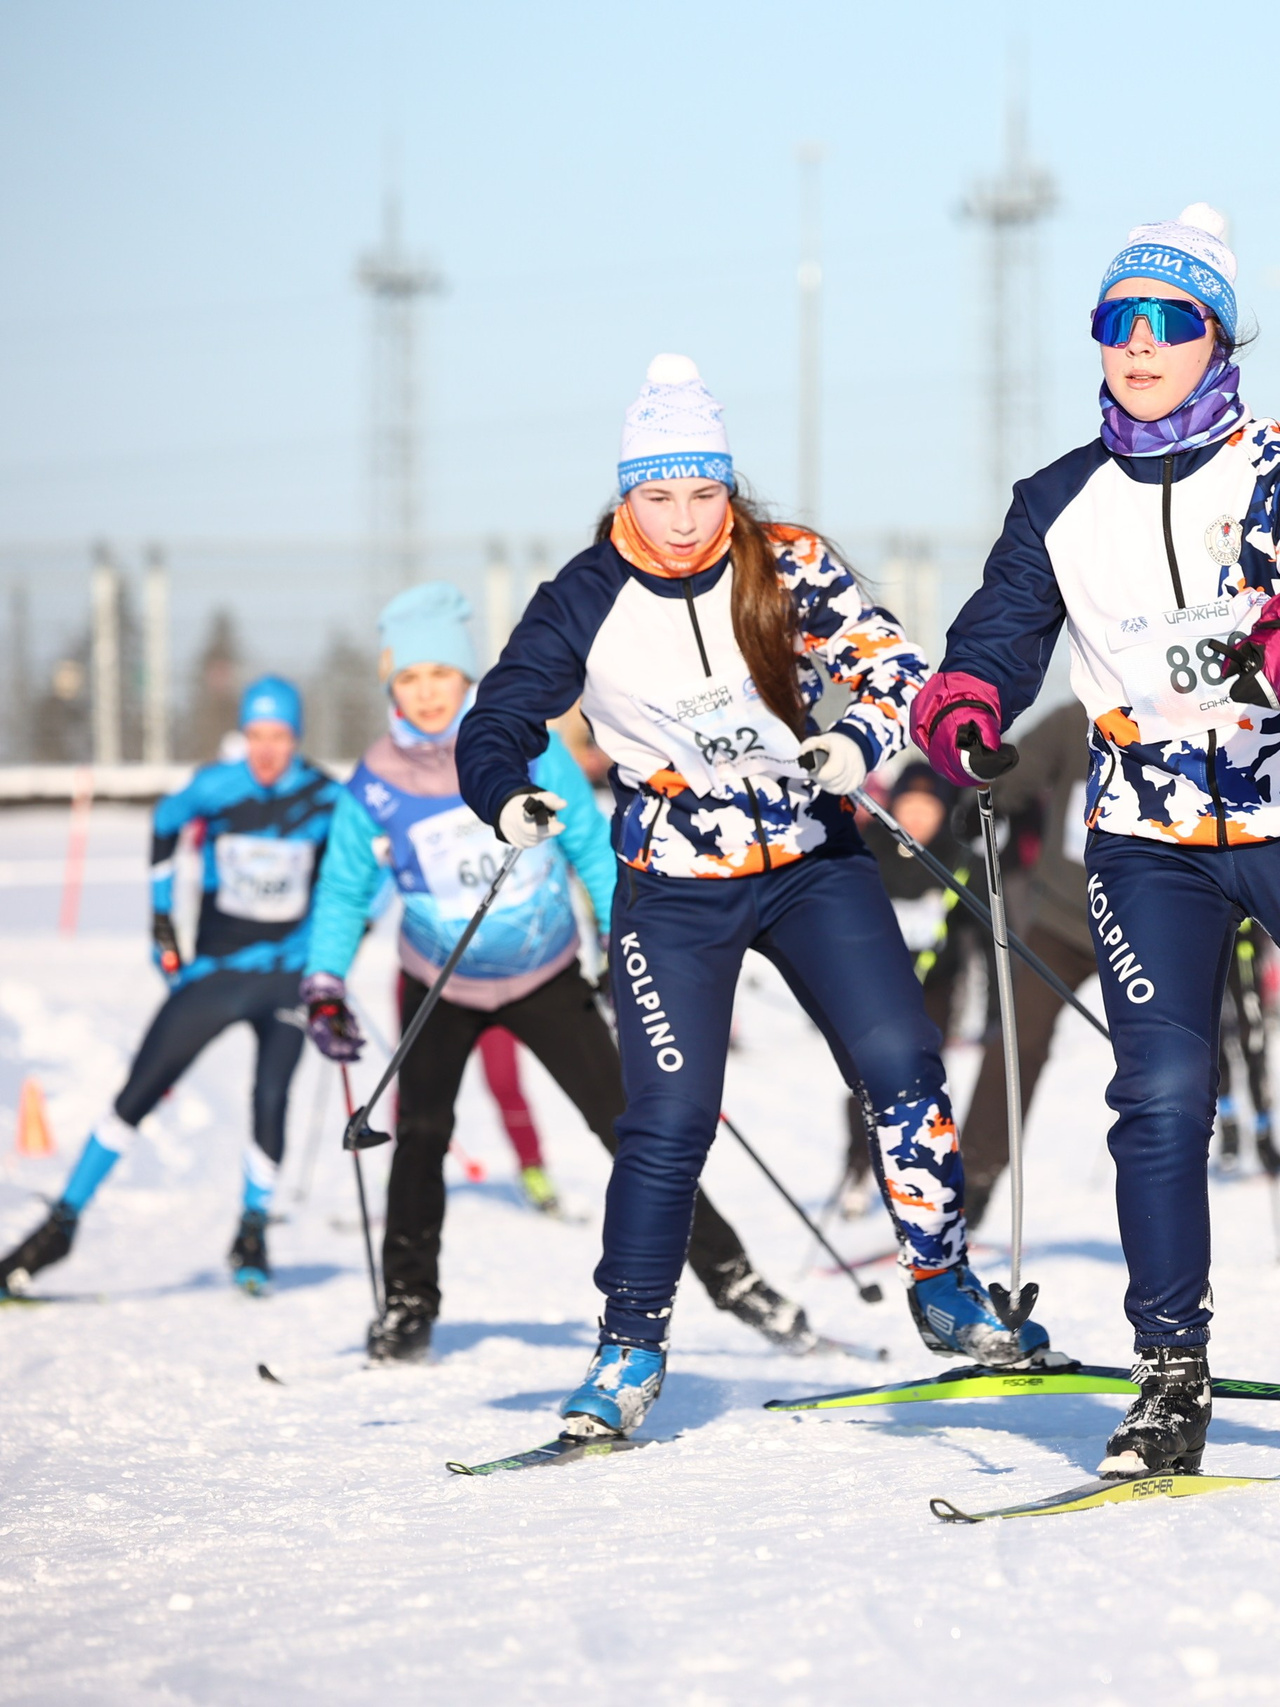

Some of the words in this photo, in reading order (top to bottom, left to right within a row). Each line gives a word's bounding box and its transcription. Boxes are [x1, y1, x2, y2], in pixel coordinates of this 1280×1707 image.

[676, 685, 730, 710] ЛЫЖНЯ
[677, 695, 733, 721] РОССИИ
[1199, 695, 1231, 711] САНК
[1088, 872, 1155, 1004] KOLPINO
[620, 931, 684, 1072] KOLPINO
[1132, 1478, 1174, 1499] FISCHER
